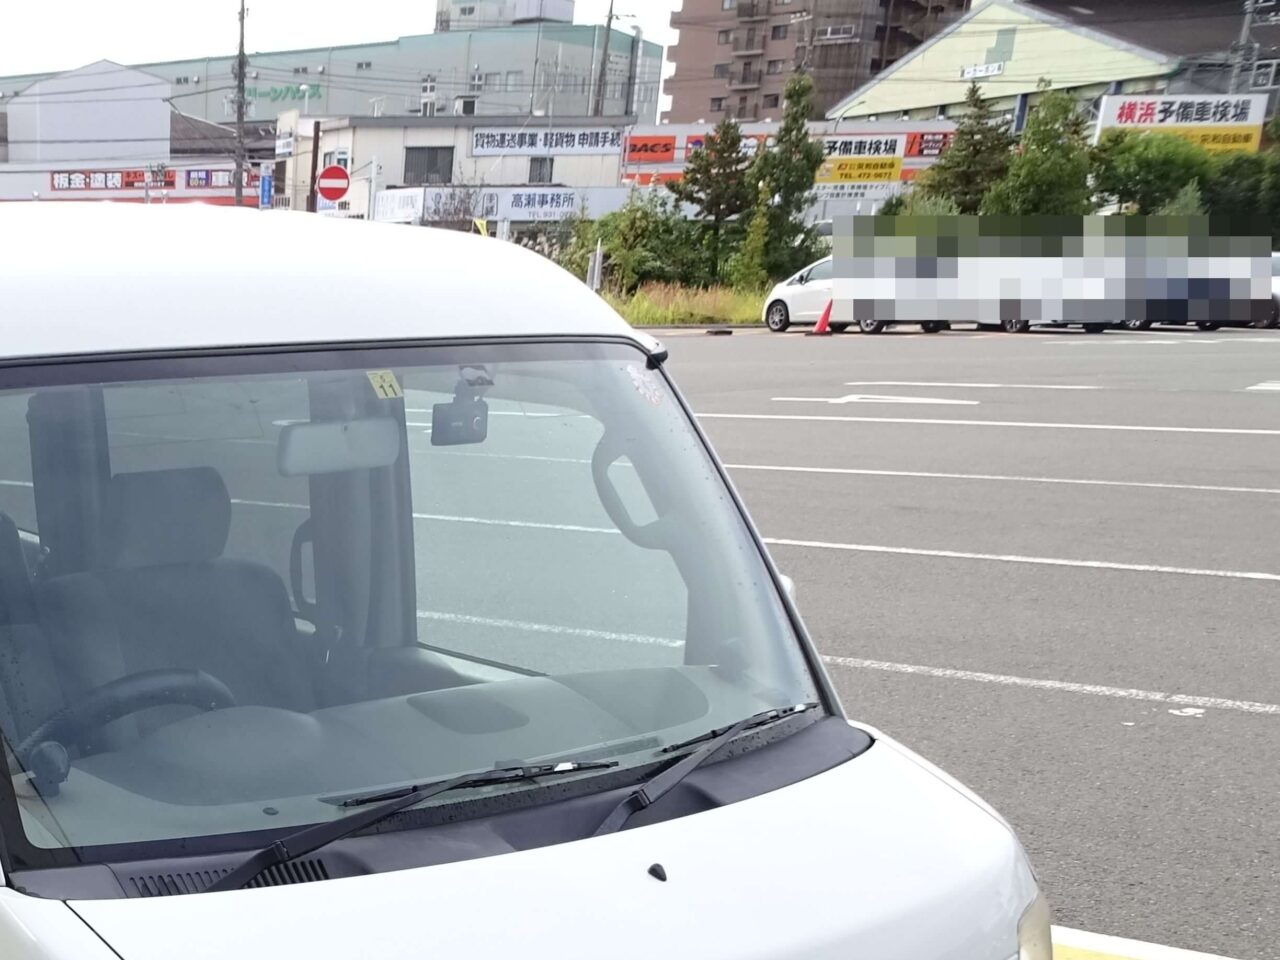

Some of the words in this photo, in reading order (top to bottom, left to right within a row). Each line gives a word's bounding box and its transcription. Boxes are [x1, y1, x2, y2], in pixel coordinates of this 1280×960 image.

[1116, 100, 1253, 123] 横浜予備車検場
[577, 131, 622, 149] 申請手続
[824, 138, 898, 157] 予備車検場
[52, 172, 122, 189] 板金・塗装
[511, 192, 575, 209] 高瀬事務所
[378, 384, 398, 397] 11
